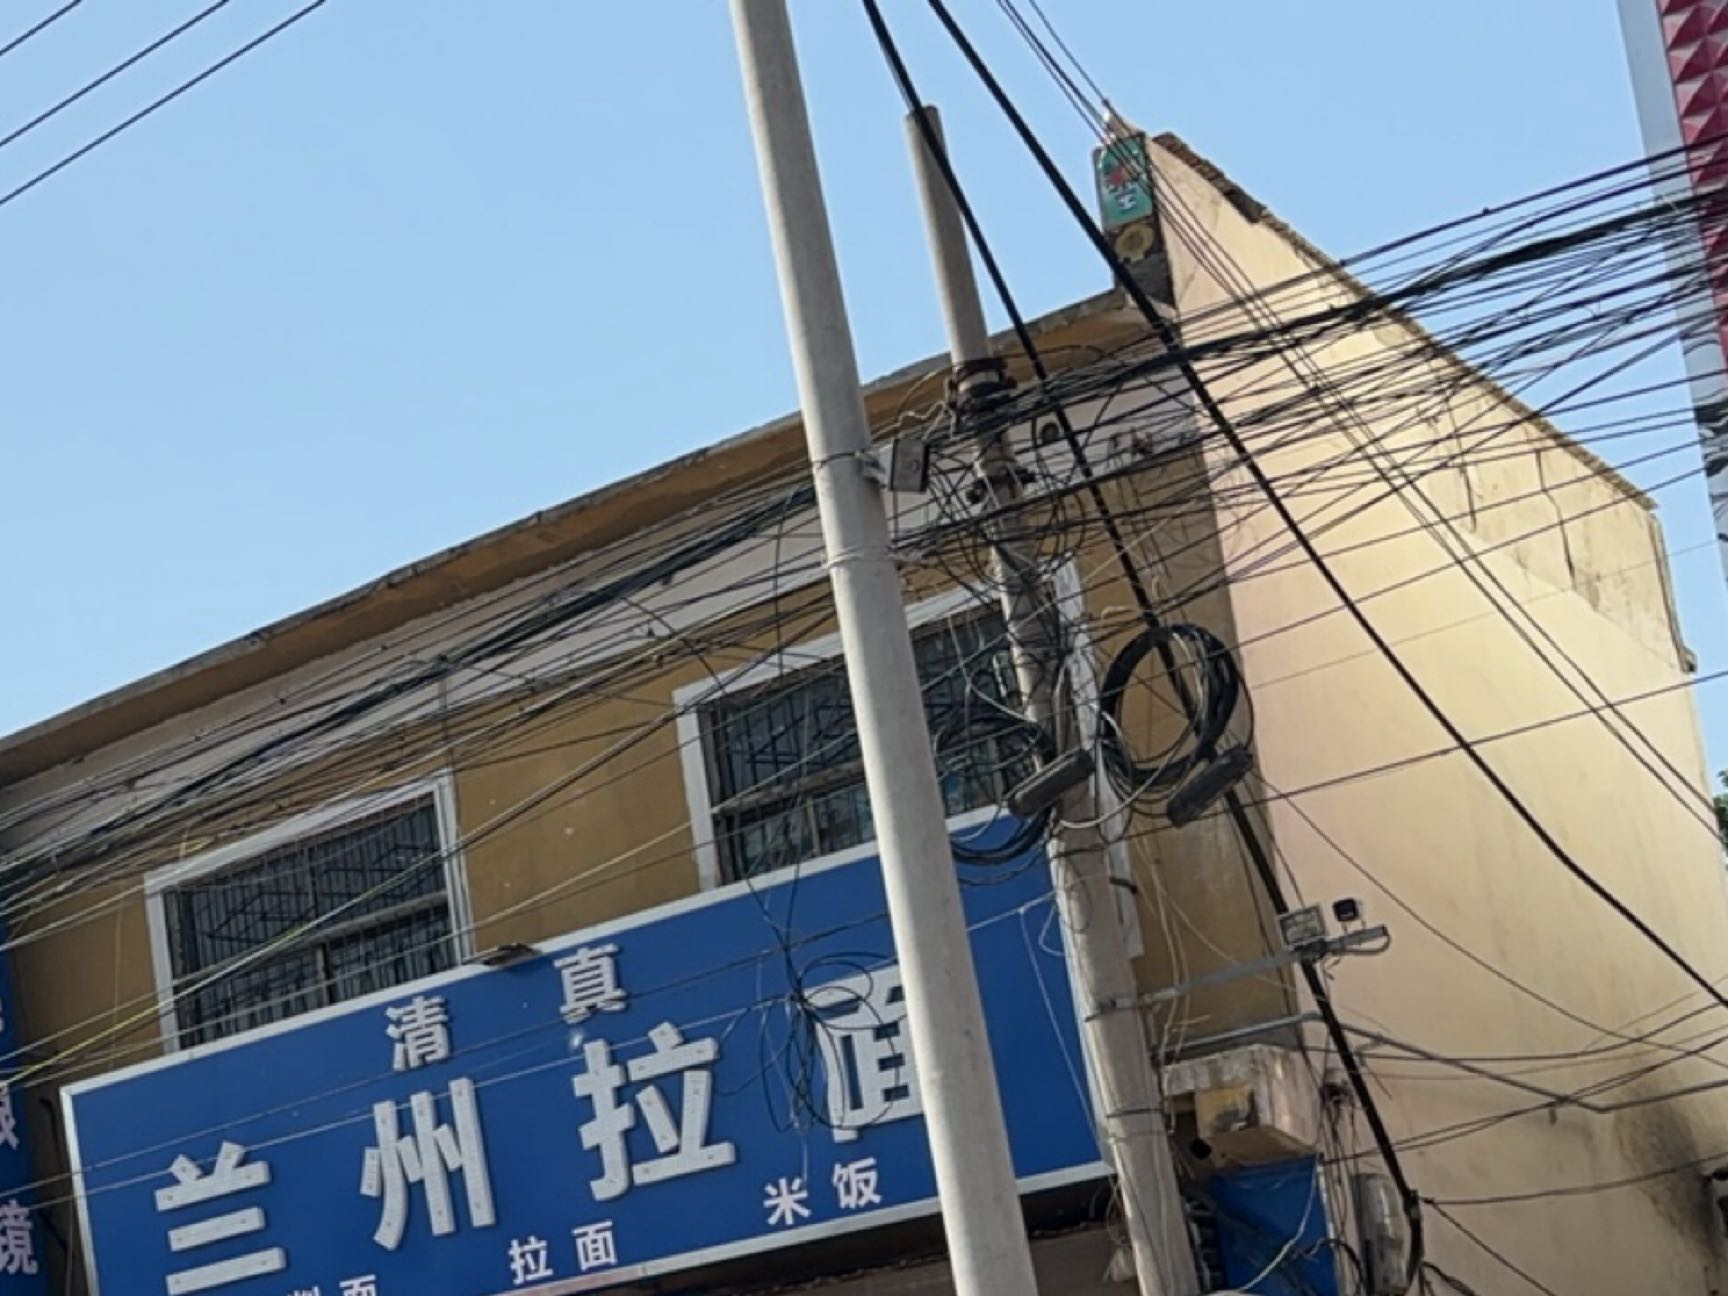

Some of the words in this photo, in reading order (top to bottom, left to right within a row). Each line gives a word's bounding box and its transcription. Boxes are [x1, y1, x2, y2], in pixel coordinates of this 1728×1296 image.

[384, 942, 629, 1072] 清真
[508, 1220, 617, 1286] 拉面
[763, 1158, 883, 1226] 米饭
